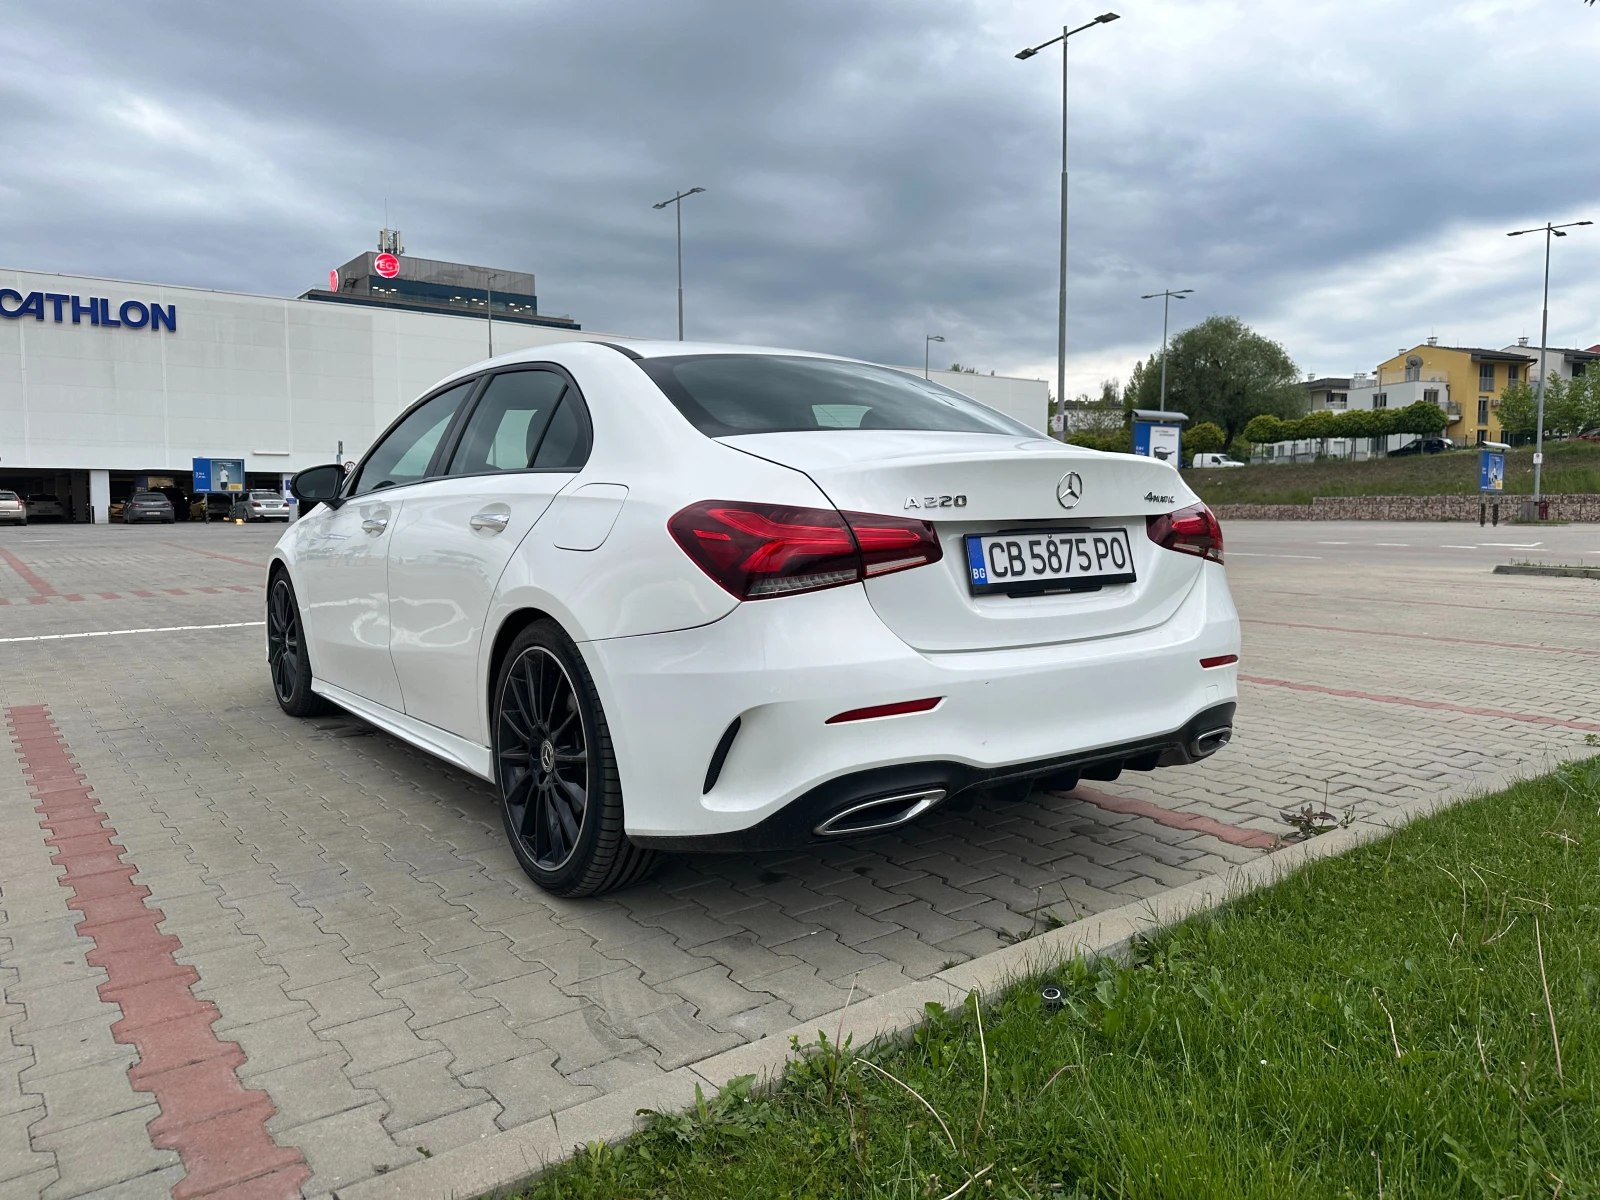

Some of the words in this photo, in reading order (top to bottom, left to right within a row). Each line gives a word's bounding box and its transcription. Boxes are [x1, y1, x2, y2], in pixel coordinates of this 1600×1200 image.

[0, 288, 177, 332] CATHLON
[904, 496, 921, 509] A
[924, 494, 967, 509] 220
[972, 567, 986, 580] BG
